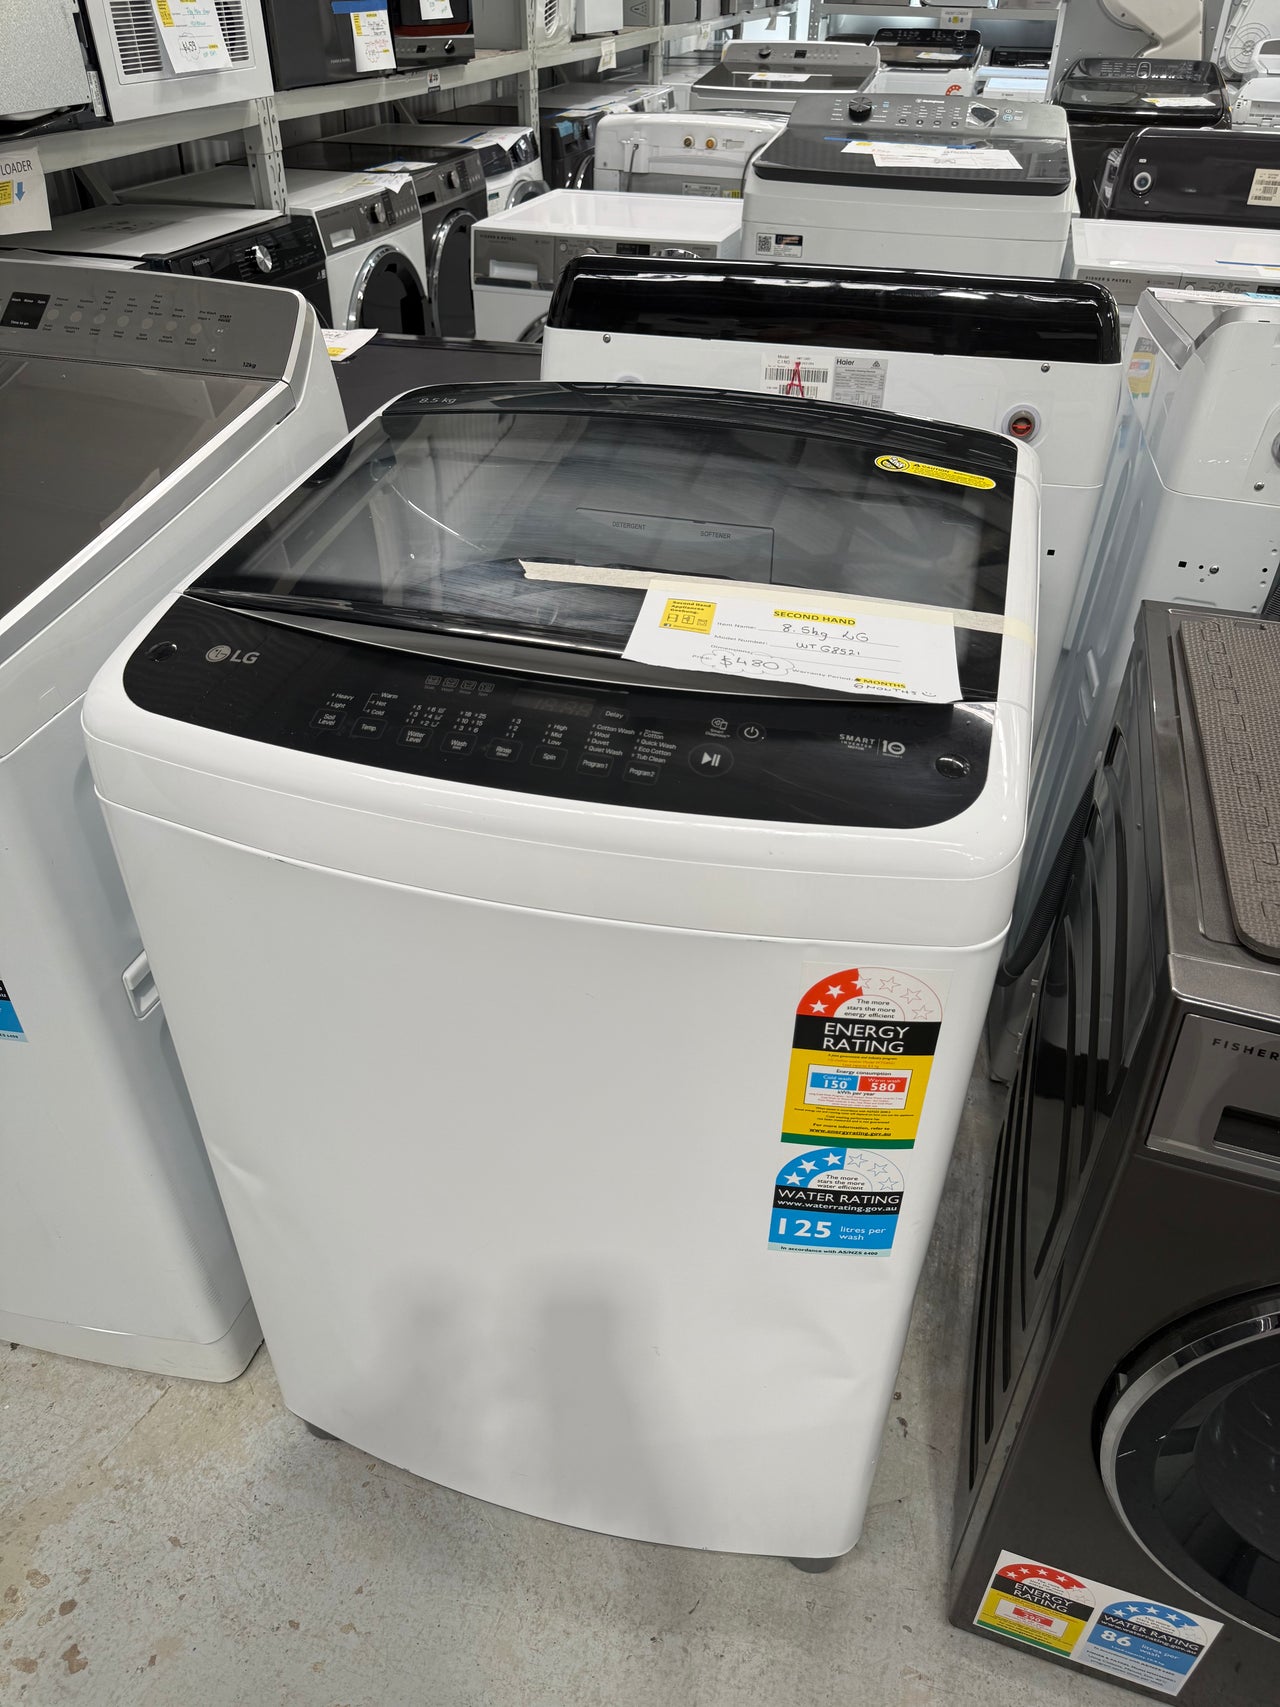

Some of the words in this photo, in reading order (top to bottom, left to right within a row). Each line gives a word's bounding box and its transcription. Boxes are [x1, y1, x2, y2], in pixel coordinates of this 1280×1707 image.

[0, 159, 33, 176] LOADER
[612, 520, 646, 531] DETERGENT
[700, 530, 732, 540] SOFTENER
[774, 610, 819, 621] SECOND
[822, 616, 856, 625] HAND
[230, 649, 261, 665] LG
[863, 679, 906, 689] MONTHS
[336, 693, 354, 701] Heavy
[330, 701, 346, 710] Light
[370, 708, 385, 716] Cold
[605, 711, 624, 719] Delay
[318, 718, 336, 726] Level
[361, 723, 377, 732] Temp
[596, 724, 617, 733] Cotton
[618, 727, 635, 735] Wash
[407, 730, 425, 738] Water
[594, 731, 610, 739] Wool
[643, 732, 664, 740] Cotton
[451, 739, 468, 748] Wash
[591, 738, 609, 746] Duvet
[640, 739, 658, 747] Quick
[659, 742, 677, 750] Wash
[840, 734, 875, 745] SMART
[496, 746, 512, 754] Rinse
[588, 745, 605, 754] Quiet
[605, 748, 623, 756] Wash
[651, 748, 672, 757] Cotton
[542, 753, 557, 761] Spin
[636, 753, 648, 761] Tub
[648, 755, 666, 763] Clean
[824, 1022, 910, 1039] ENERGY
[822, 1038, 905, 1054] RATING
[1212, 1038, 1280, 1061] FISHER
[823, 1080, 848, 1089] 150
[871, 1082, 896, 1091] 580
[778, 1189, 835, 1203] WATER
[840, 1195, 900, 1204] RATING
[777, 1200, 898, 1213] www.waterrating.gov.au
[778, 1218, 832, 1239] 125
[840, 1226, 865, 1234] litres
[1014, 1582, 1074, 1607] ENERGY
[1013, 1590, 1068, 1613] RATING
[1104, 1614, 1146, 1634] WATER
[1150, 1630, 1200, 1651] RATING
[1100, 1630, 1132, 1647] 86
[1140, 1648, 1161, 1659] wash
[1141, 1644, 1163, 1655] litres
[1164, 1652, 1180, 1660] per
